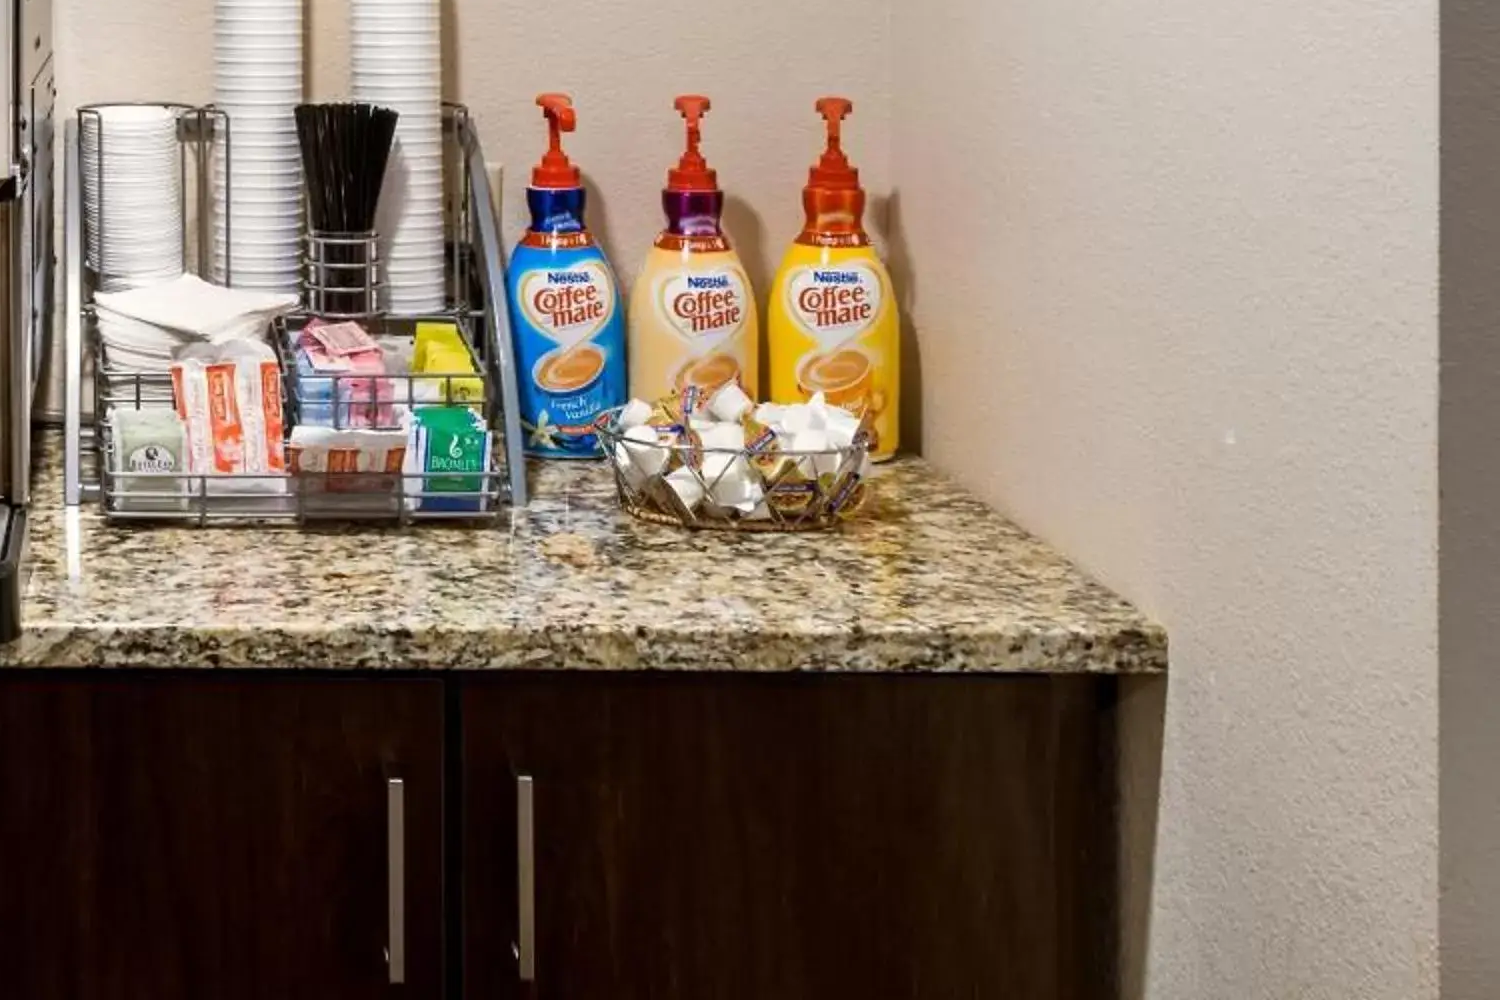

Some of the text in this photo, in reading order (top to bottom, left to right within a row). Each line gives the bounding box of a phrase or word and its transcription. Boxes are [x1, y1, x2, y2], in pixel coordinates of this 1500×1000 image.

[534, 285, 597, 315] Coffee
[673, 289, 735, 319] Coffee
[798, 285, 865, 313] Coffee
[553, 301, 605, 328] mate
[691, 306, 741, 333] mate
[816, 303, 871, 327] mate
